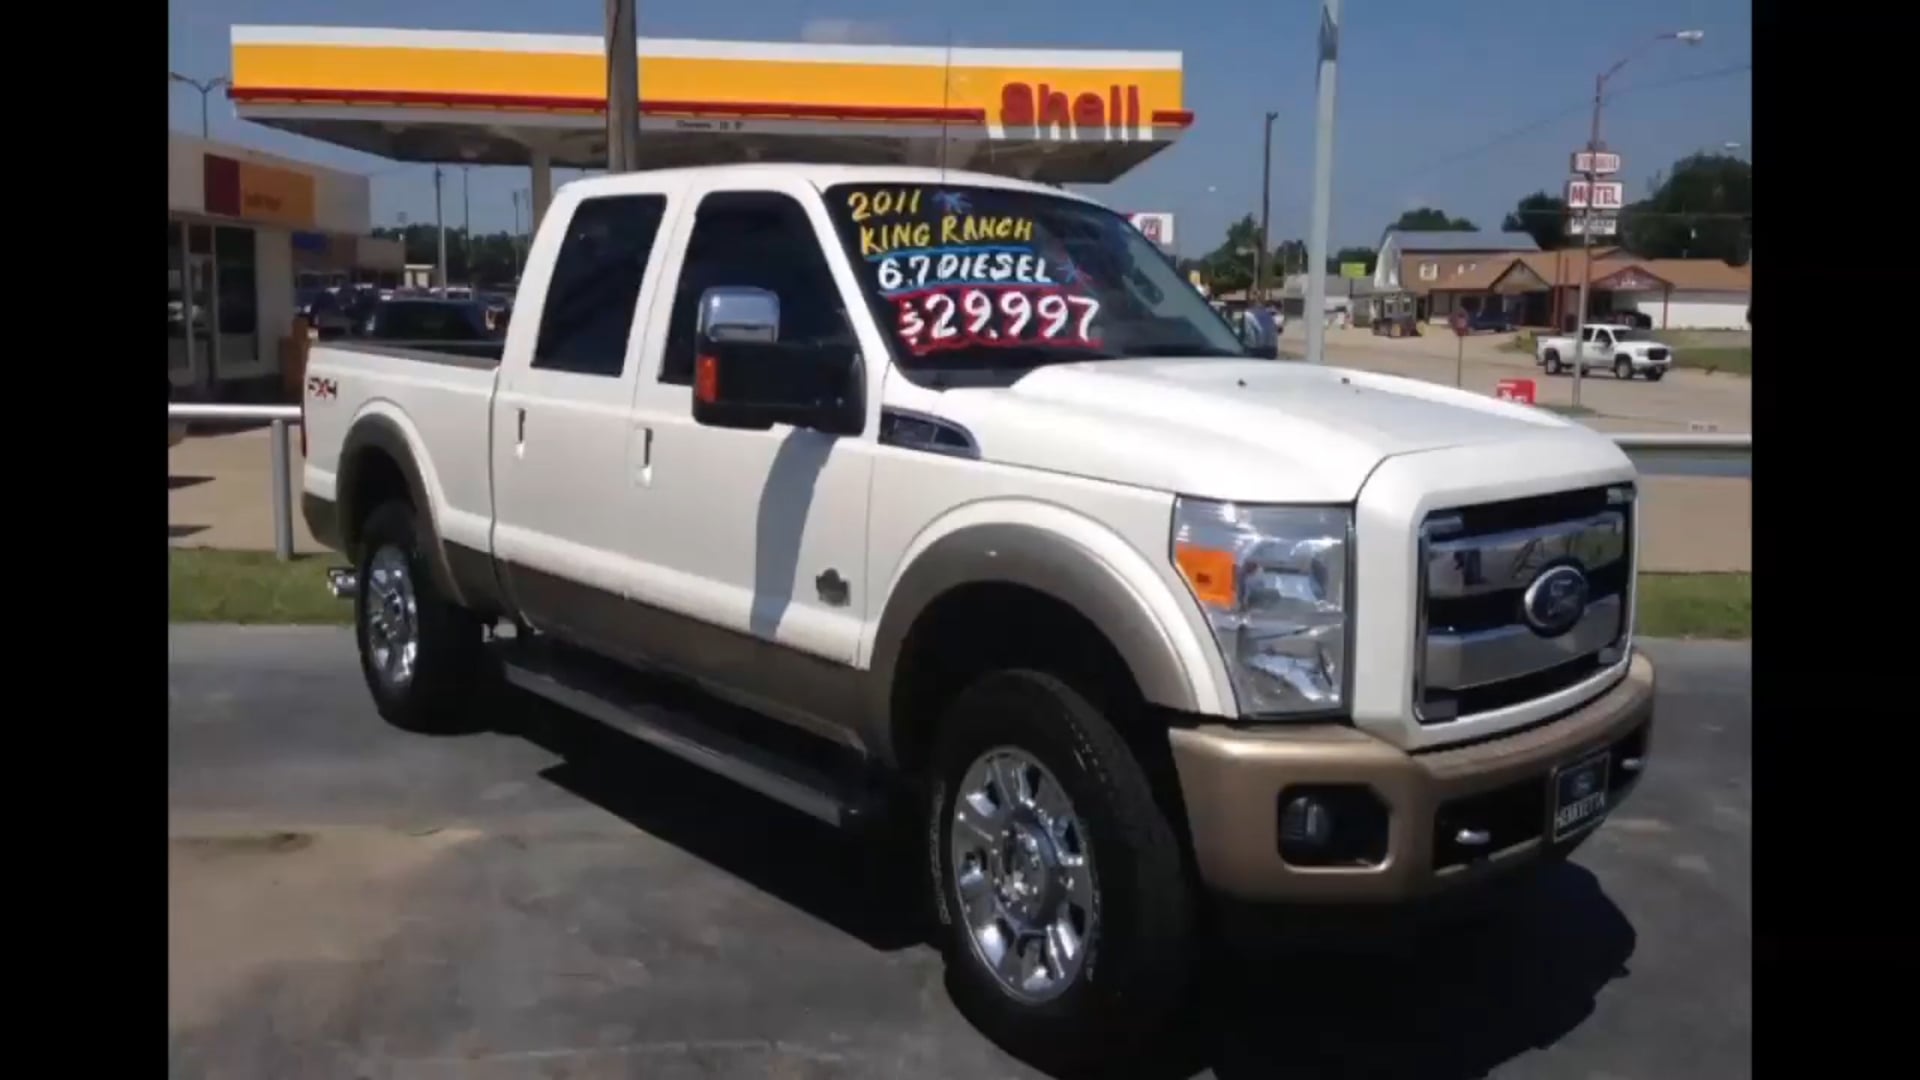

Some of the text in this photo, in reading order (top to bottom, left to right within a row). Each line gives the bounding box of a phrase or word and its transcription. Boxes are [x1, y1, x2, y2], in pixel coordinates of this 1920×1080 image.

[1000, 82, 1141, 130] Shell
[847, 188, 922, 222] 2011
[860, 214, 1034, 256] KING RANCH
